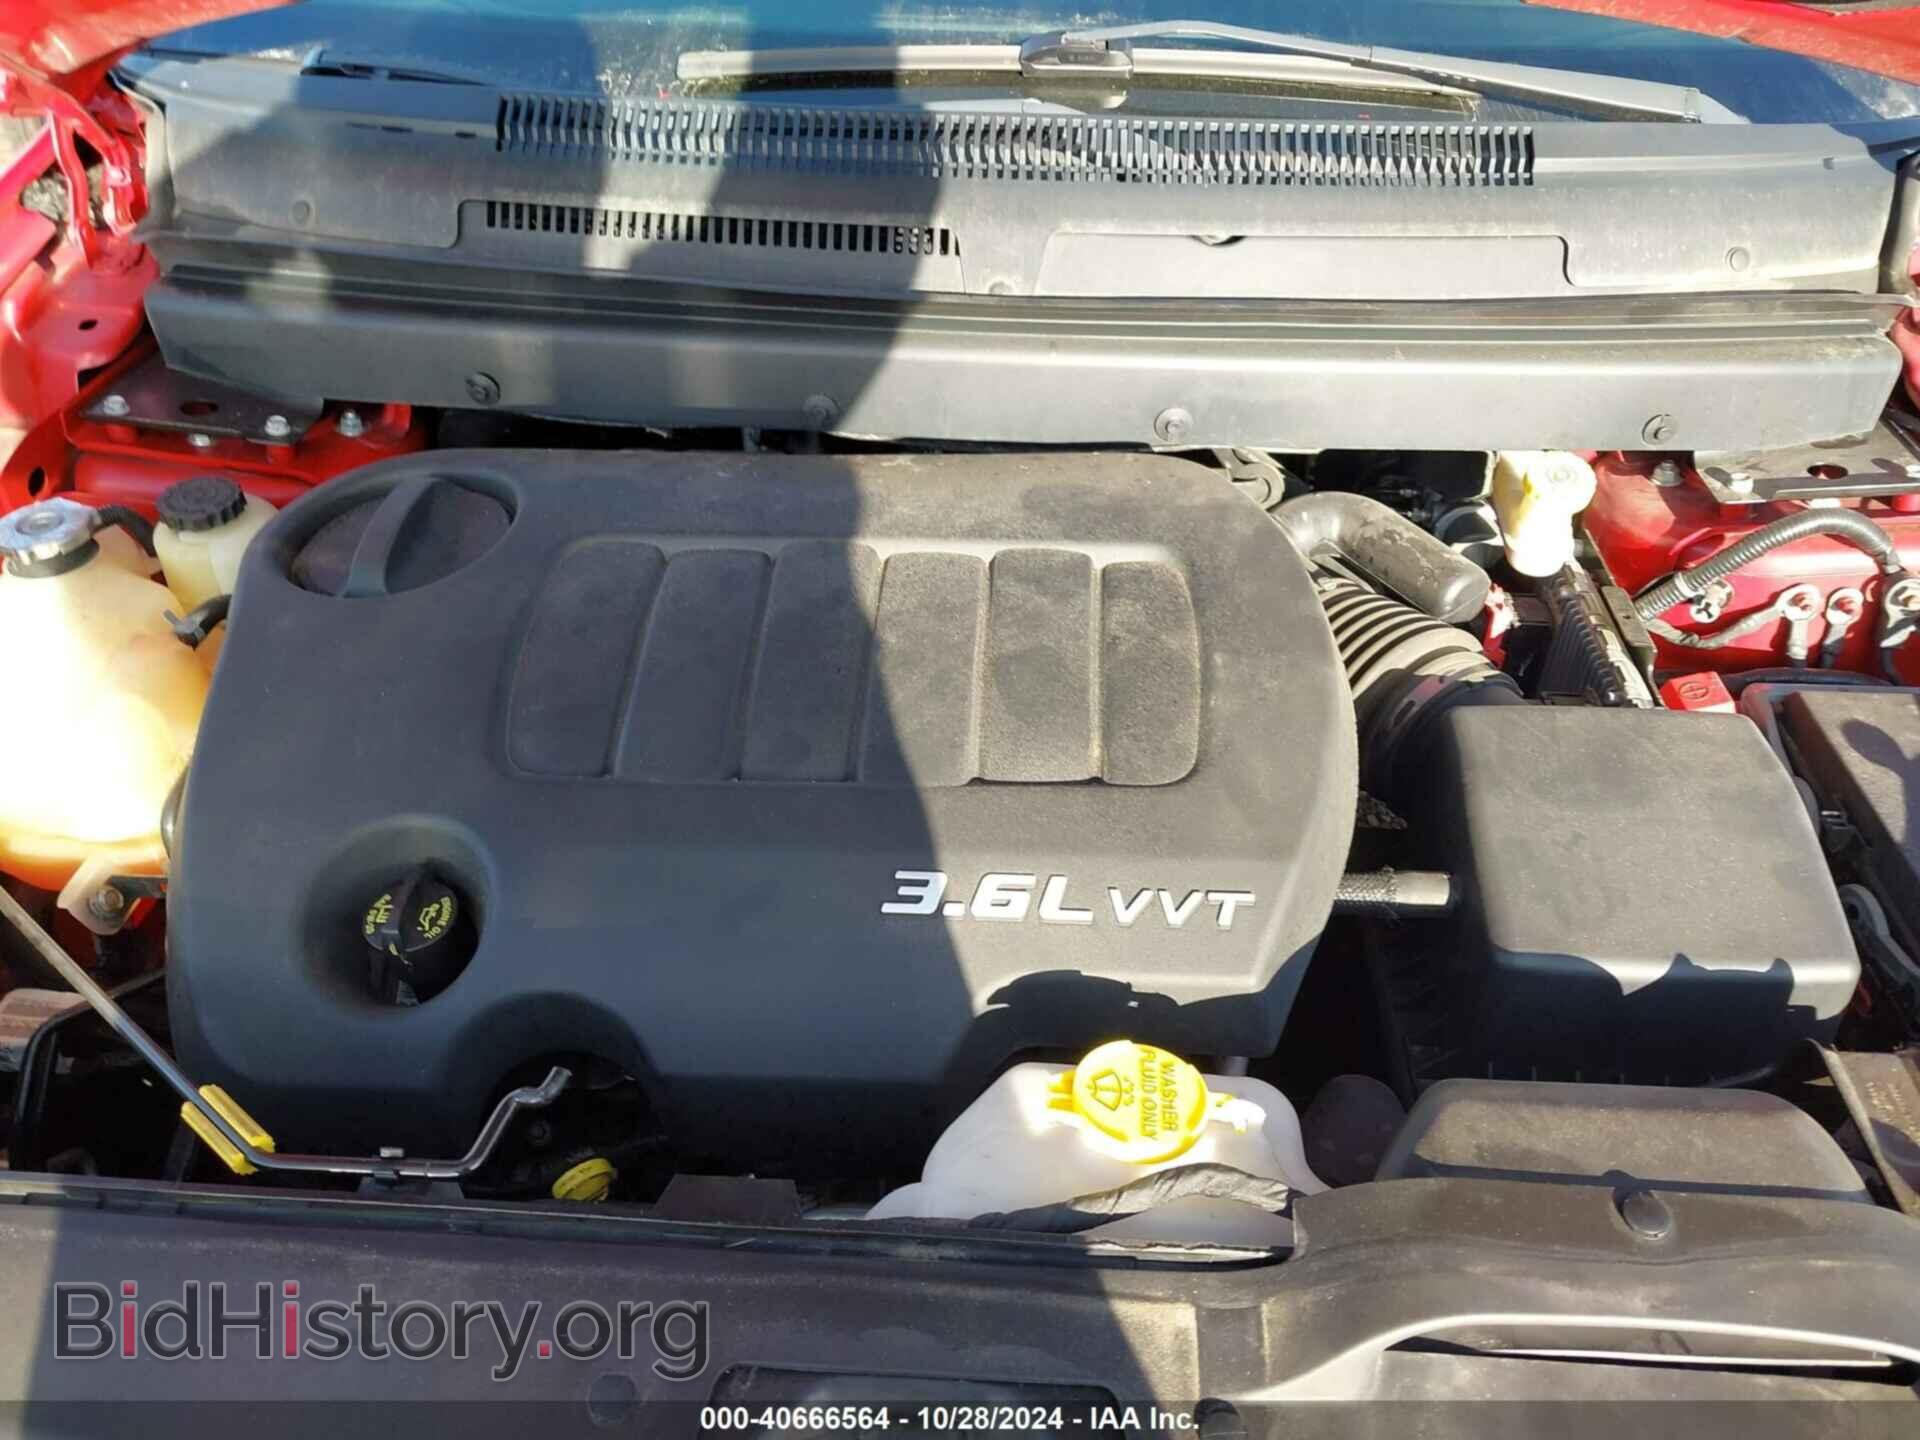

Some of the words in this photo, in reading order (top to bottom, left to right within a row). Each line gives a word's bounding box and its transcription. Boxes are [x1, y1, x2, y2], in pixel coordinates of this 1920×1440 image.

[881, 870, 1094, 925] 3.6L
[1107, 886, 1256, 931] VVT
[1140, 1047, 1157, 1094] FLUID
[1160, 1060, 1178, 1132] WASHER
[1141, 1096, 1158, 1140] ONLY
